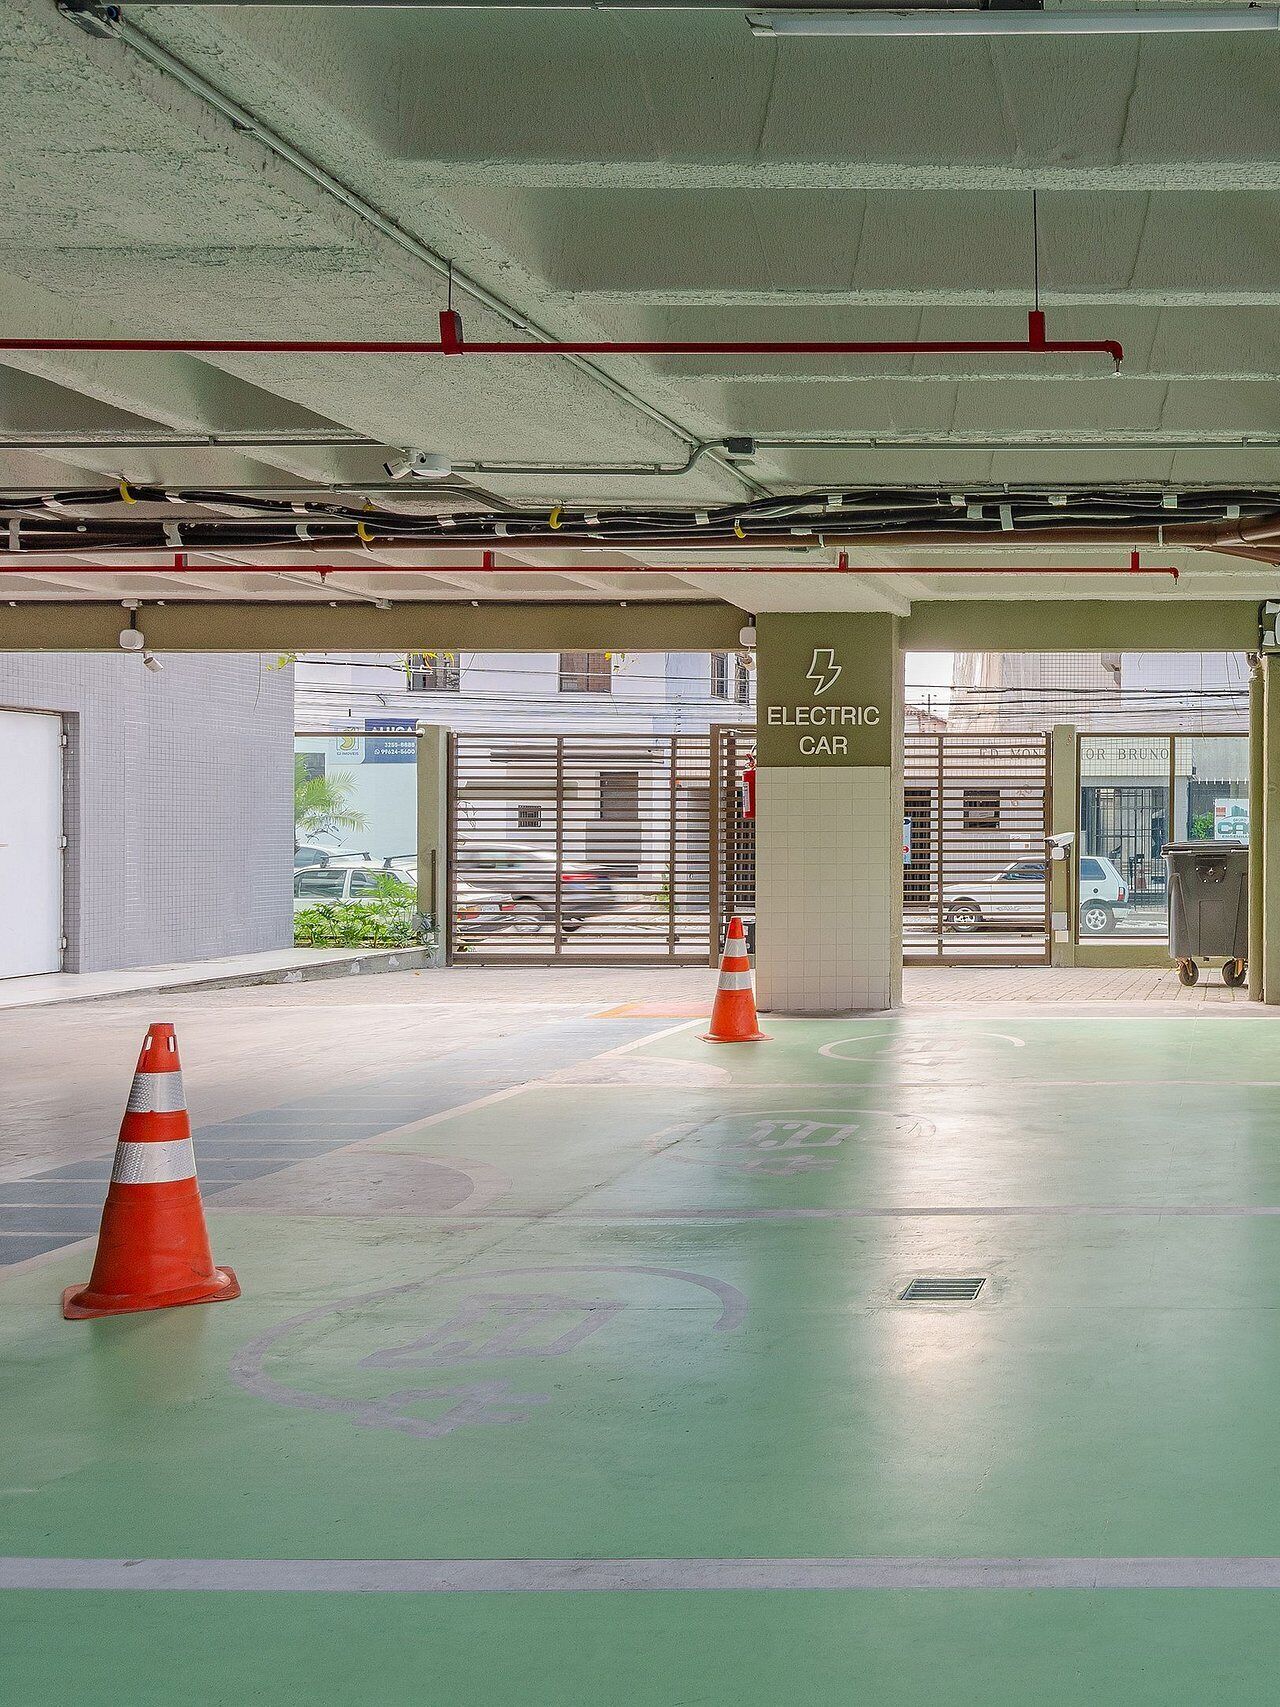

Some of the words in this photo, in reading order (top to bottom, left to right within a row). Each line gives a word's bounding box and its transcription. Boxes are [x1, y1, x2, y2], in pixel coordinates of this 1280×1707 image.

[767, 706, 880, 726] ELECTRIC
[799, 736, 848, 755] CAR
[1117, 748, 1169, 760] BRUNO
